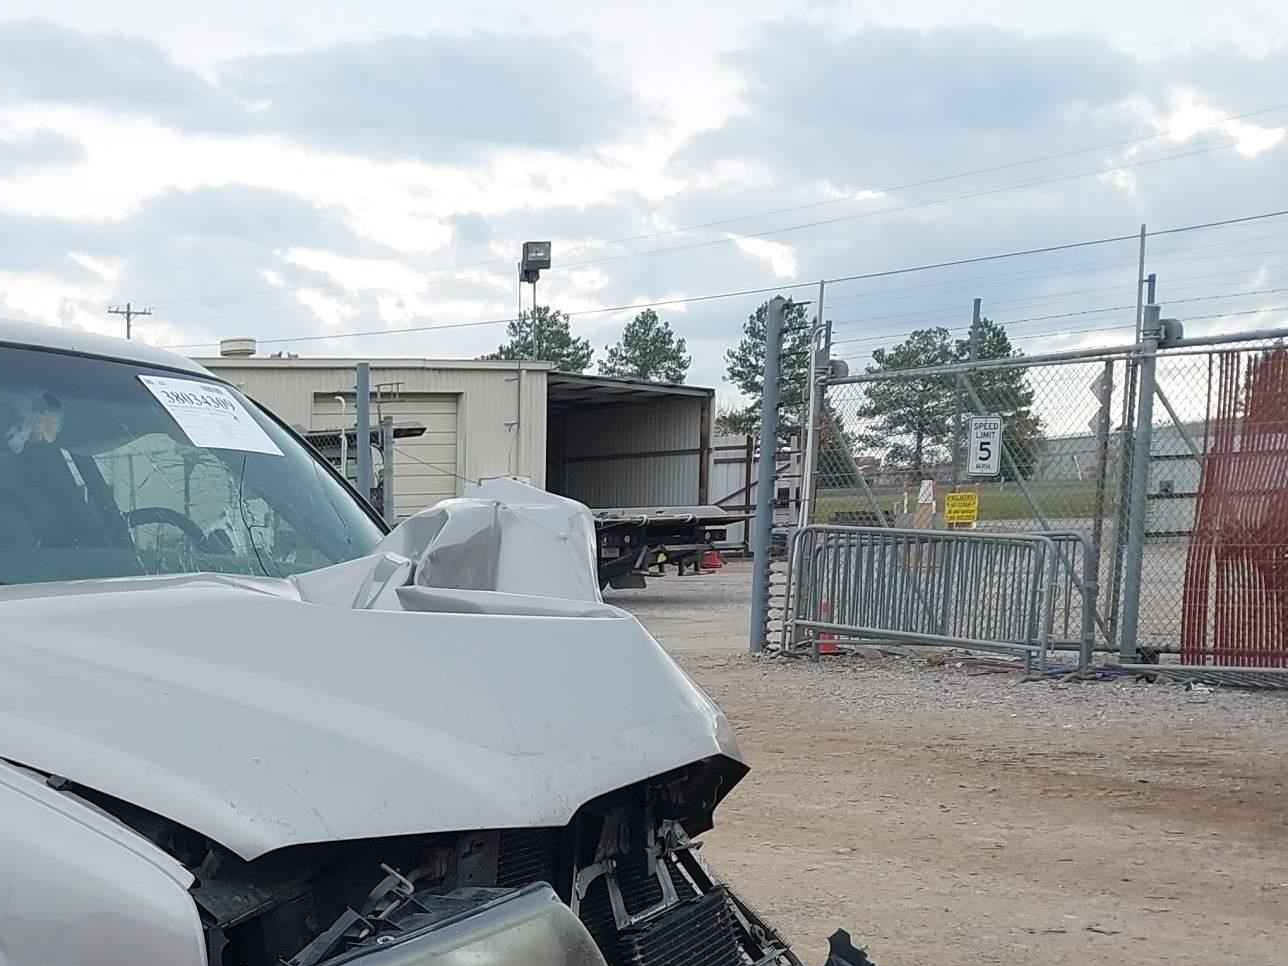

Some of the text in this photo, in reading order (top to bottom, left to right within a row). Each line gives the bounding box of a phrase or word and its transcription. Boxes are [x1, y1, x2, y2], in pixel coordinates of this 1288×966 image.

[160, 390, 236, 411] 38034309
[974, 422, 999, 430] SPEED
[976, 431, 996, 439] LIMIT
[978, 441, 992, 461] 5
